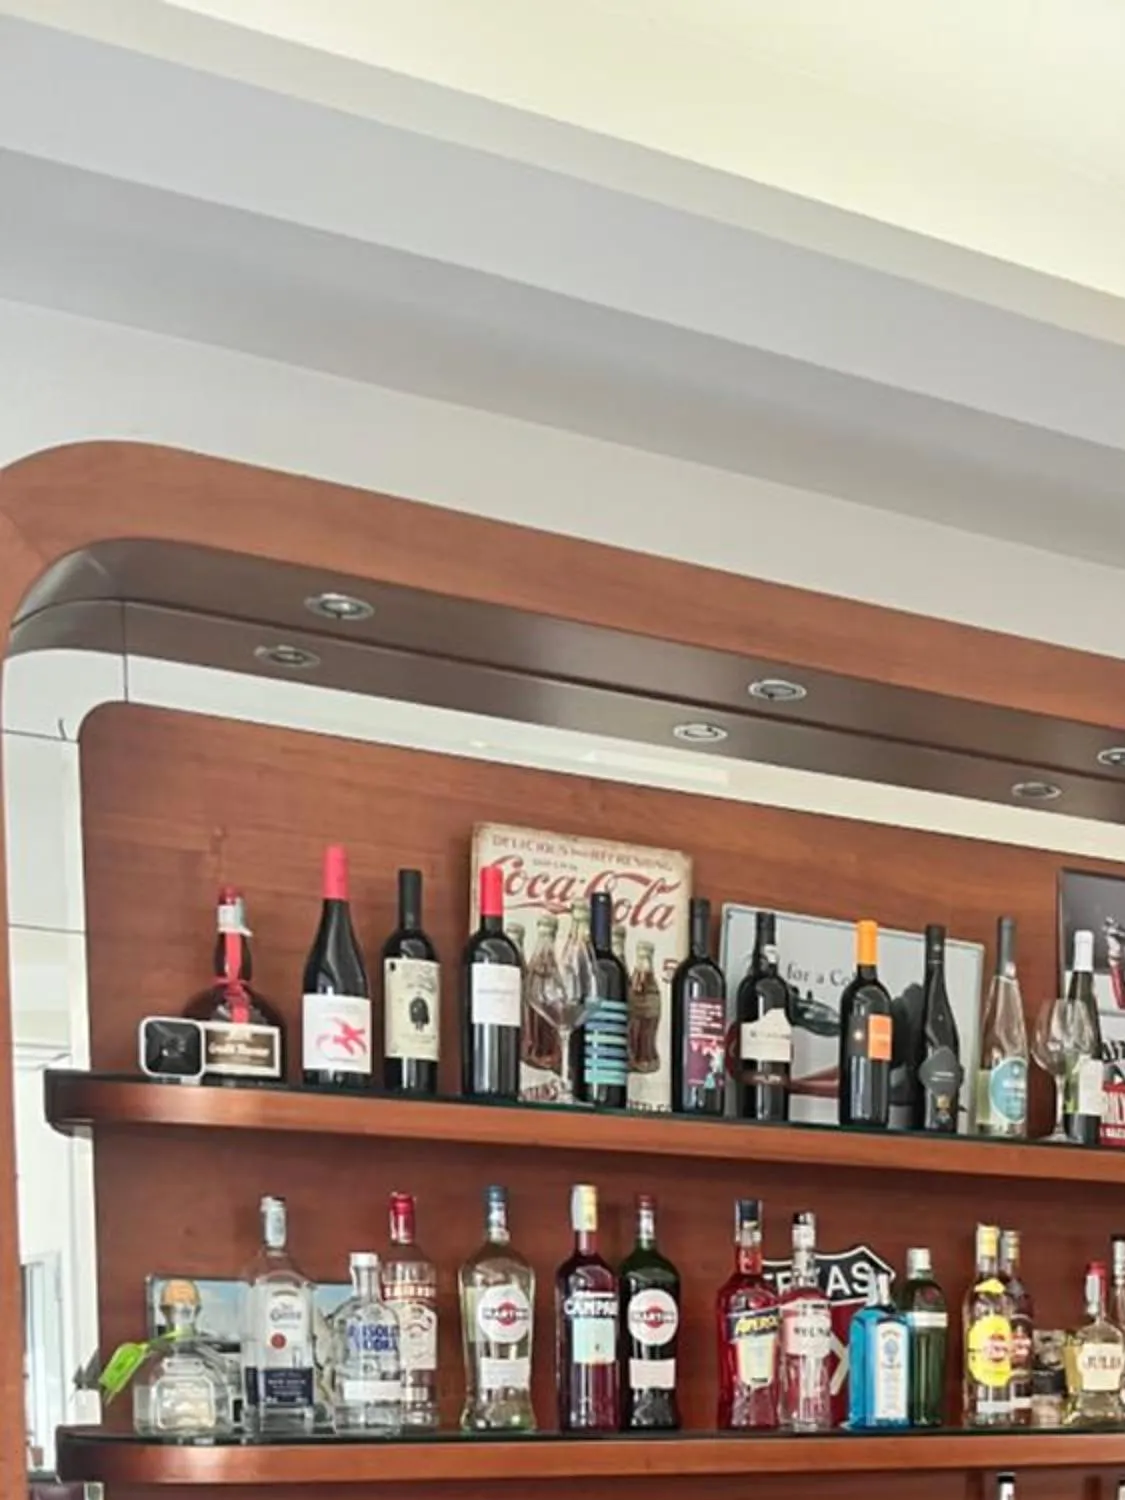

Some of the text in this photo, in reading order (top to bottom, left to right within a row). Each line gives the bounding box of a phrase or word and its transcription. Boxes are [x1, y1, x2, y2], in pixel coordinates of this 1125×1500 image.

[787, 963, 809, 983] for
[816, 972, 826, 984] a
[763, 1261, 876, 1299] EAS
